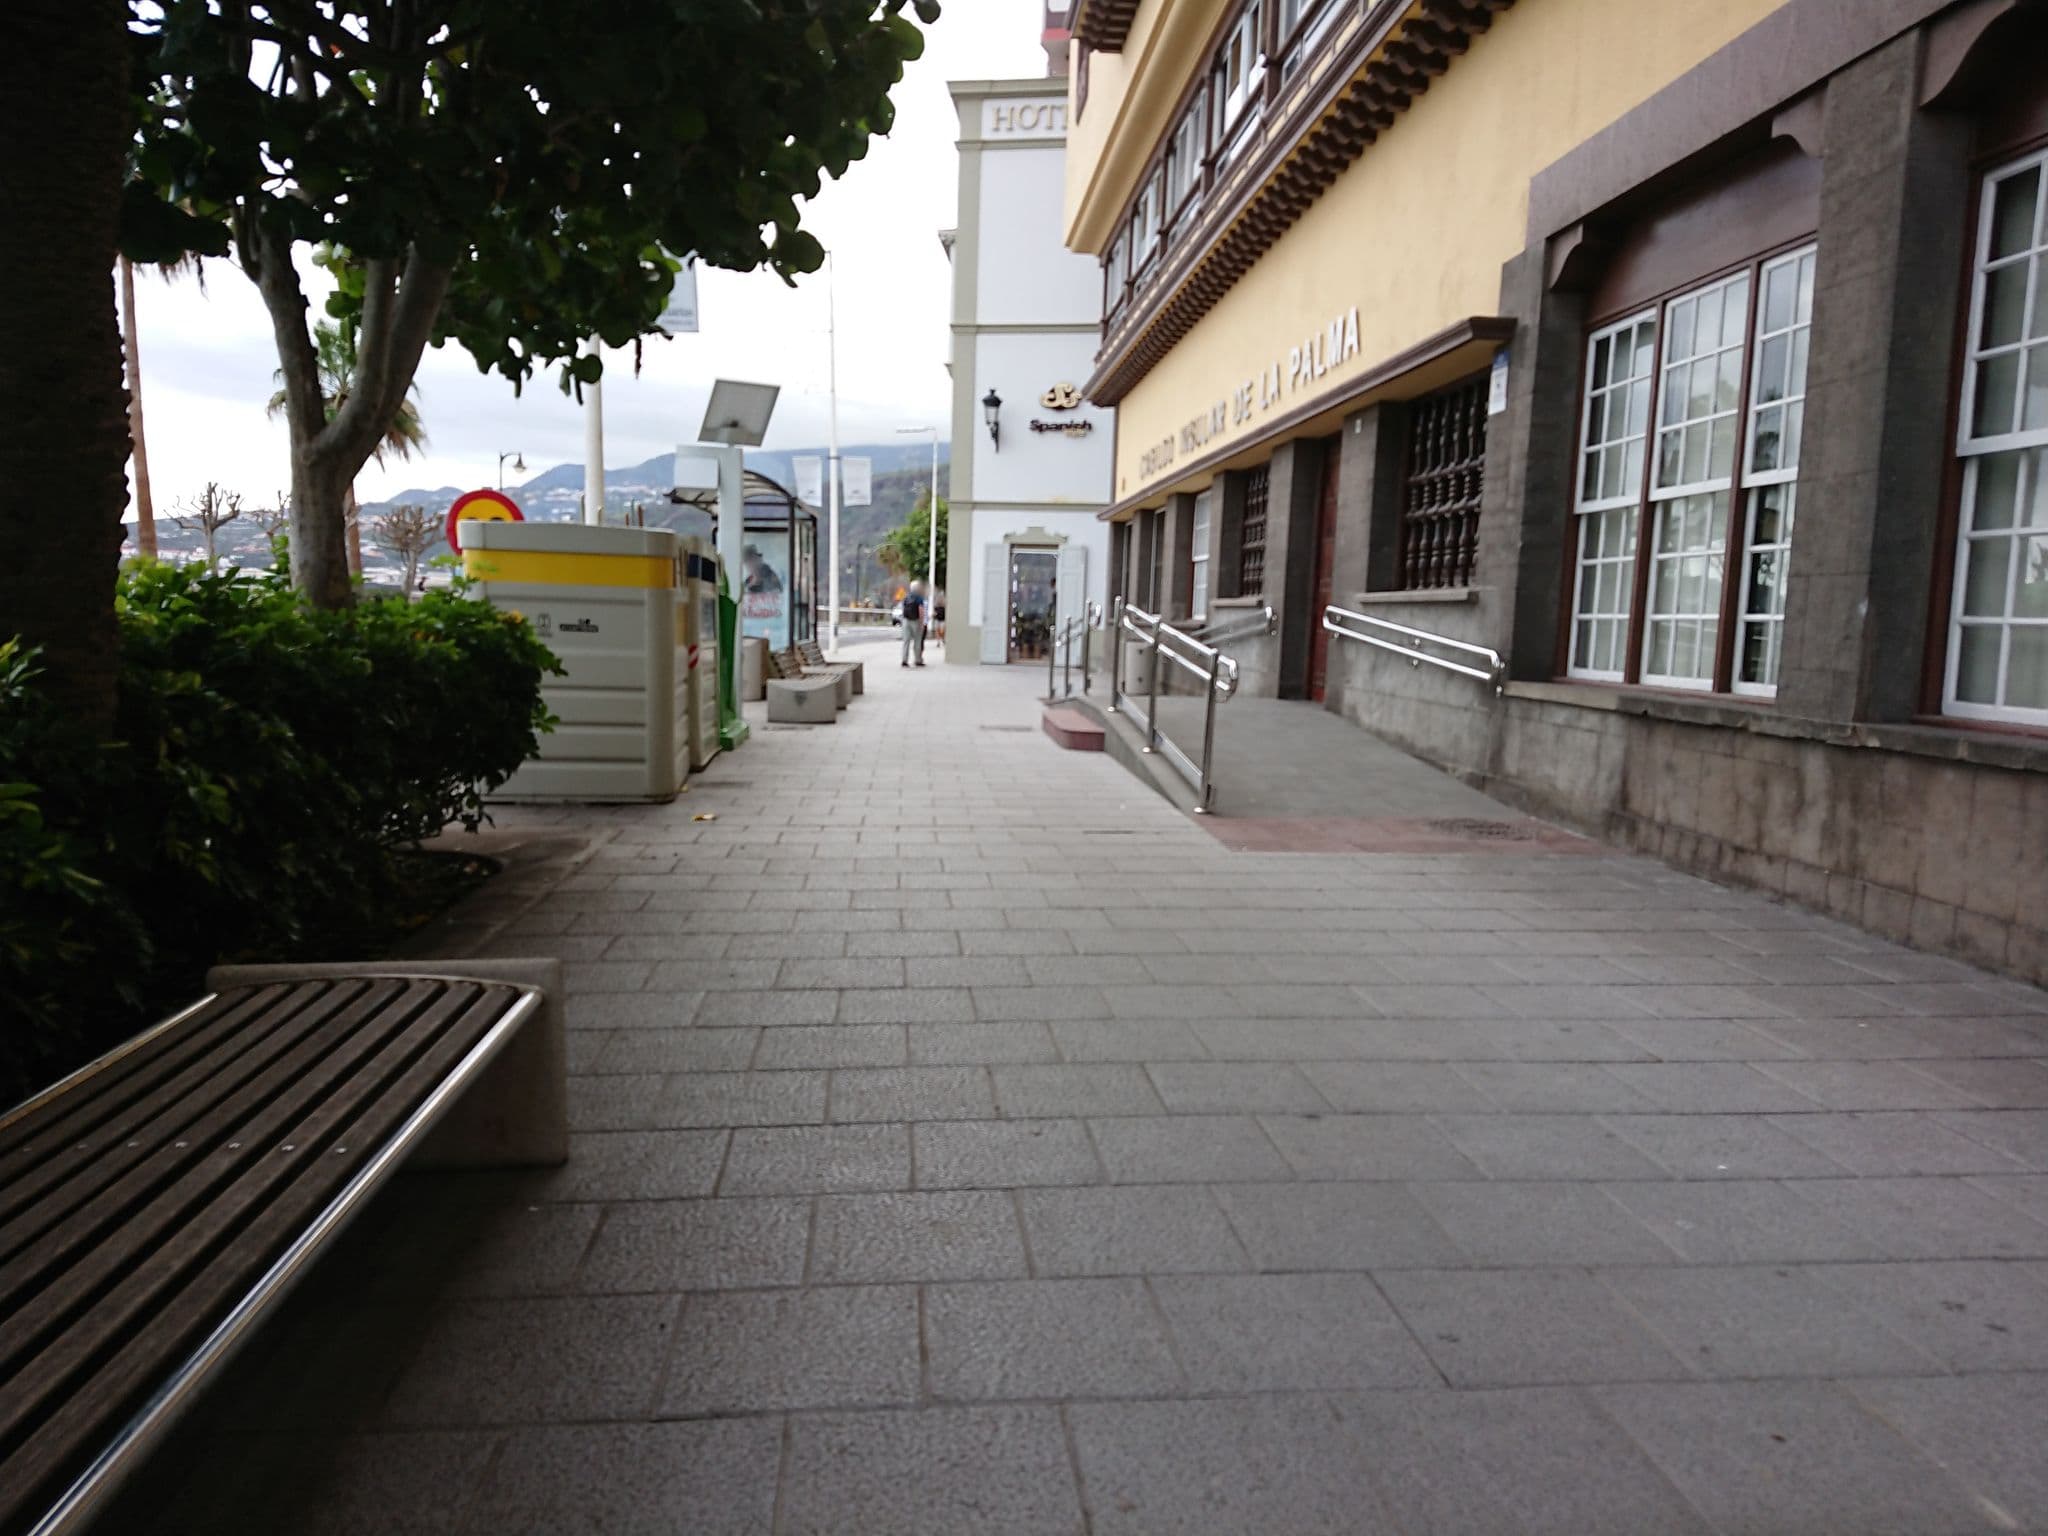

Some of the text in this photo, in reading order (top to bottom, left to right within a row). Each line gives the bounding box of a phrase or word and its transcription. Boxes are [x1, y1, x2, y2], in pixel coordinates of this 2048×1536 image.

[1232, 379, 1253, 426] DE
[1258, 359, 1281, 410] LA
[1288, 304, 1361, 393] PALMA
[1029, 419, 1092, 434] Spanish
